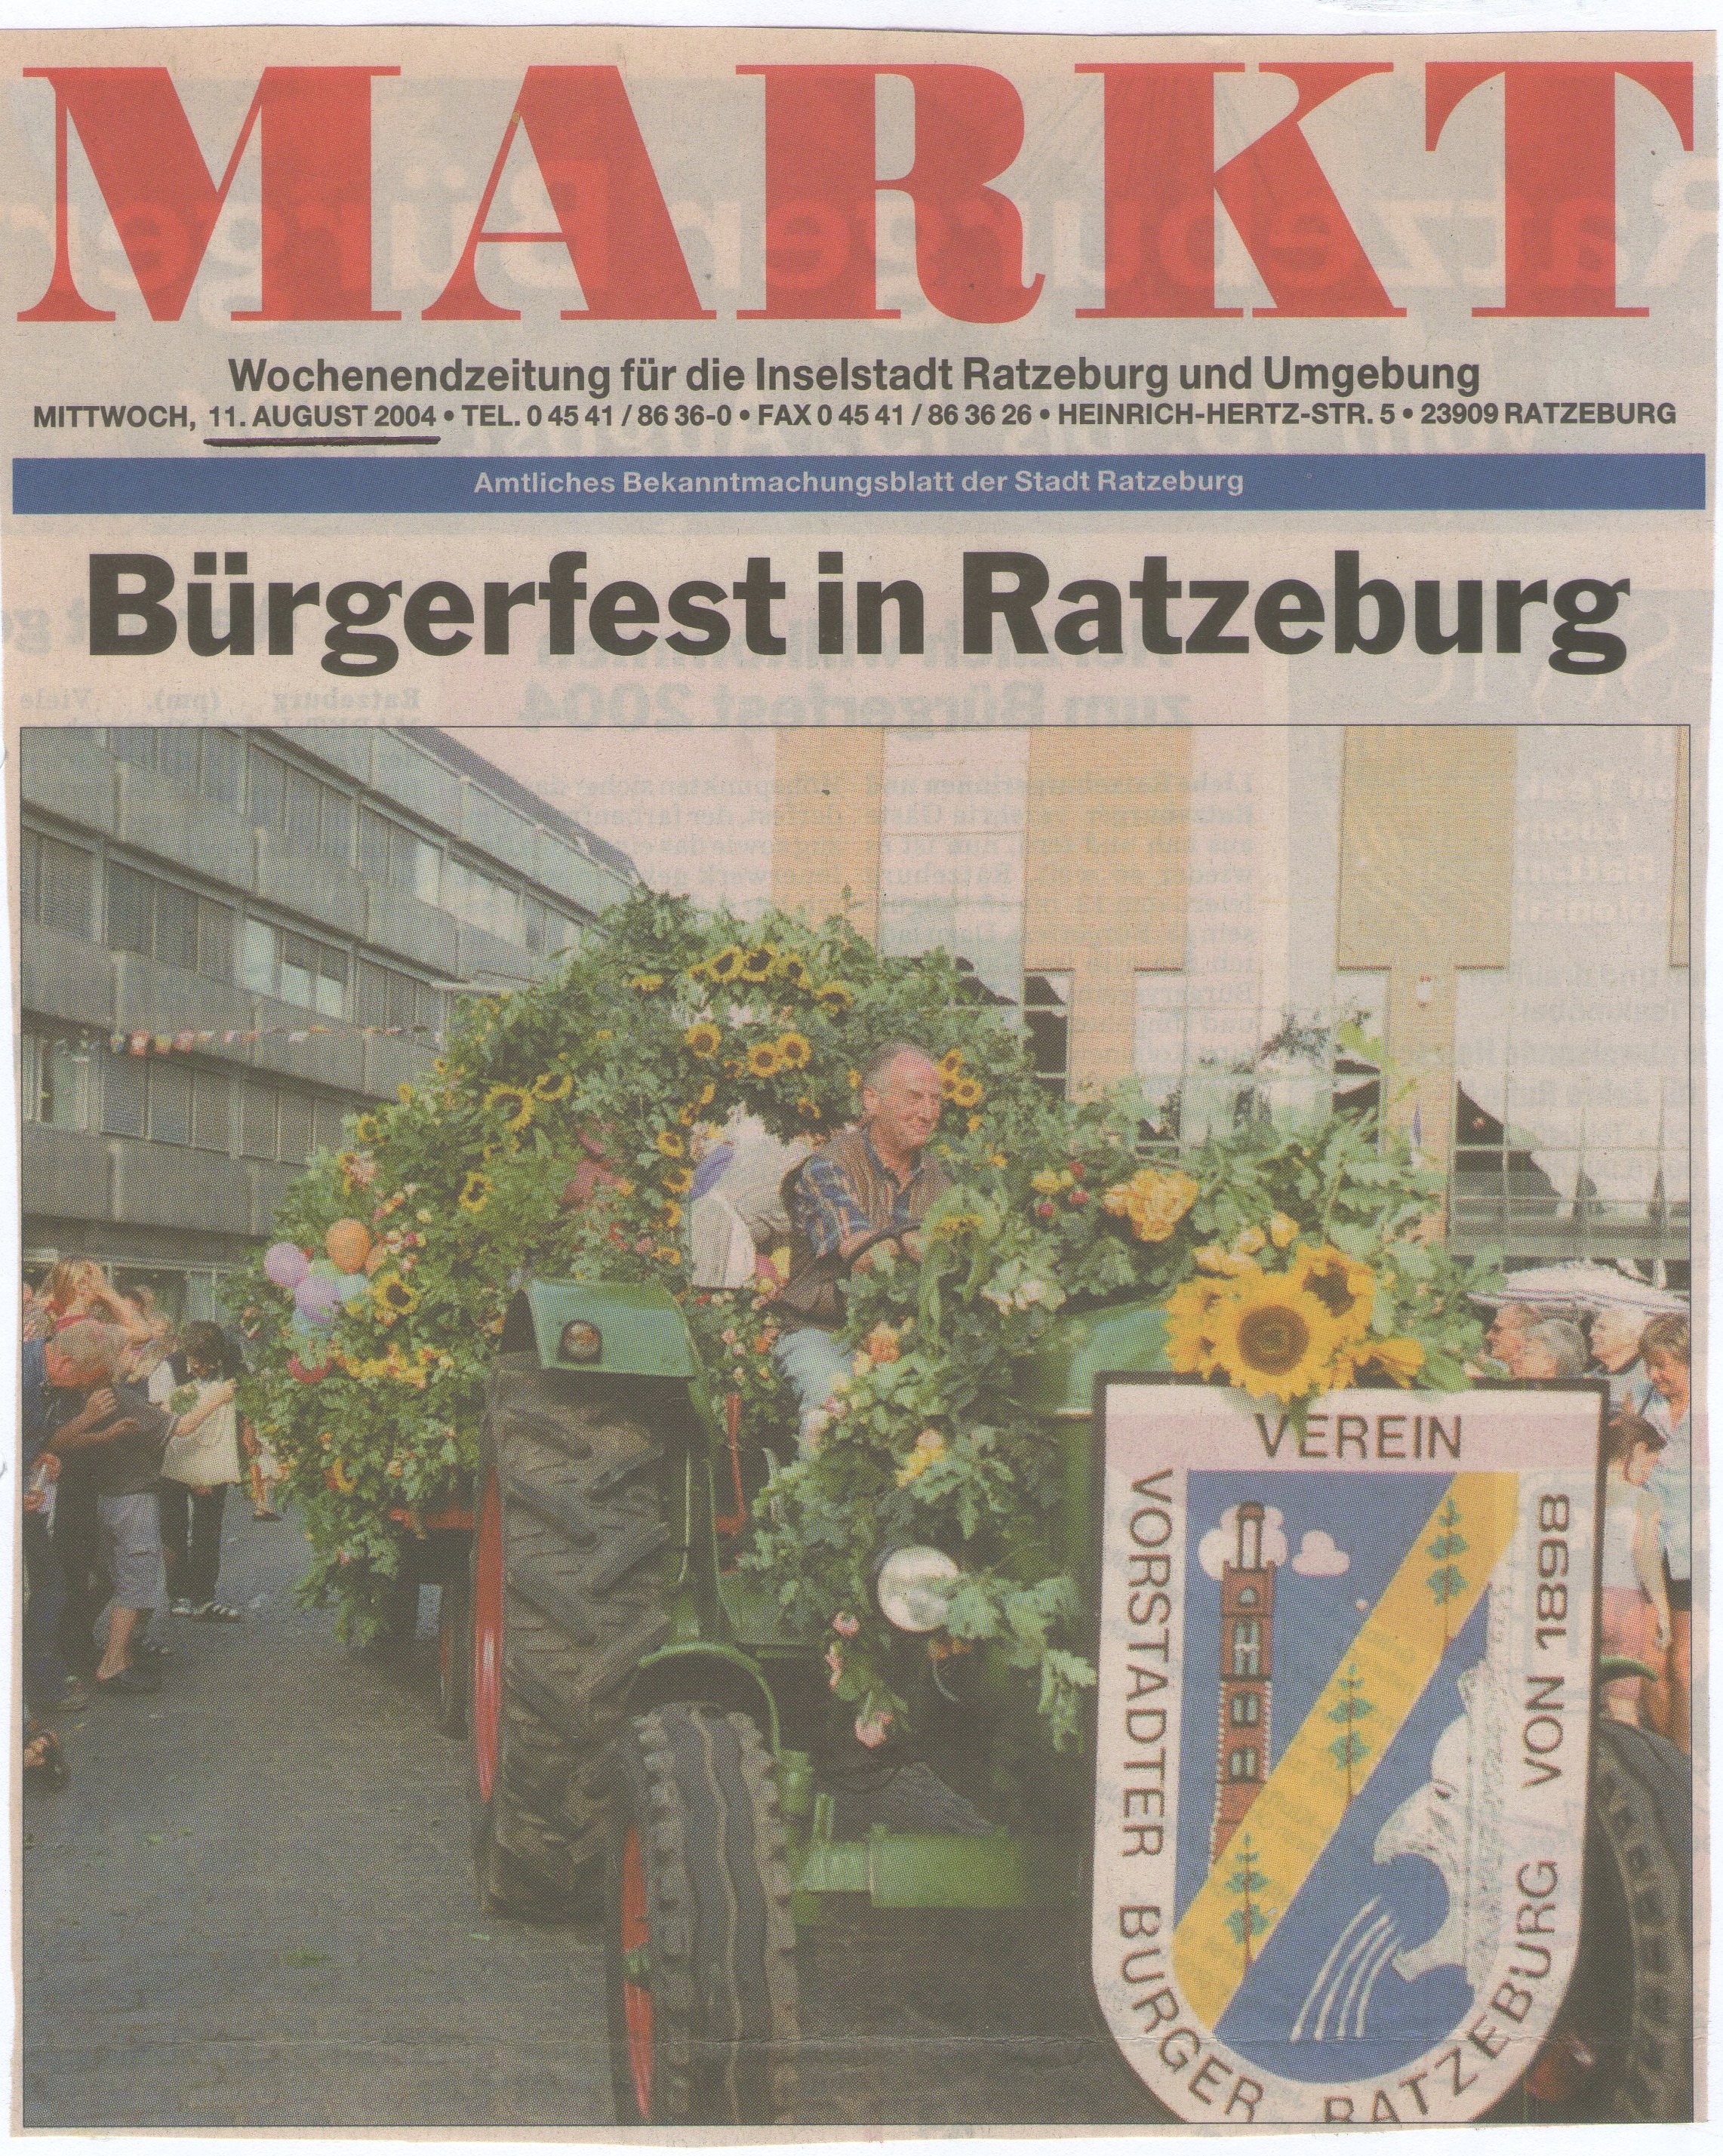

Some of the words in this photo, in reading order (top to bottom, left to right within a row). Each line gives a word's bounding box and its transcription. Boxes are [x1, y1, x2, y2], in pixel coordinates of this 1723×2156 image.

[17, 60, 1694, 324] MARKT
[35, 406, 195, 431] MITTWOCH,
[210, 406, 245, 426] 11.
[253, 405, 368, 426] AUGUST
[374, 405, 436, 426] 2004
[462, 405, 520, 426] TEL.
[759, 404, 811, 425] FAX
[1060, 404, 1373, 424] HEINRICH-HERTZ-STR.
[1421, 403, 1498, 424] 23909
[1506, 403, 1675, 424] RATZEBURG
[229, 358, 609, 398] Wochenendzeitung
[621, 358, 676, 391] für
[687, 358, 744, 391] die
[757, 358, 952, 390] Inselstadt
[965, 357, 1167, 398] Ratzeburg
[1180, 356, 1251, 389] und
[1265, 356, 1478, 397] Umgebung
[474, 472, 614, 493] Amtliches
[624, 471, 954, 497] Bekanntmachungsblatt
[962, 471, 1008, 491] der
[1015, 471, 1090, 492] Stadt
[1098, 470, 1243, 497] Ratzeburg
[90, 551, 786, 677] Bürgerfest
[819, 552, 924, 654] in
[964, 550, 1629, 675] Ratzeburg
[1254, 1413, 1463, 1460] VEREIN
[1534, 1493, 1571, 1650] 1898
[1121, 1468, 1174, 1858] VORSTADTER
[1520, 1675, 1566, 1788] VON
[1118, 1903, 1265, 2123] BURGER
[1323, 1859, 1558, 2123] RATZEBURG
